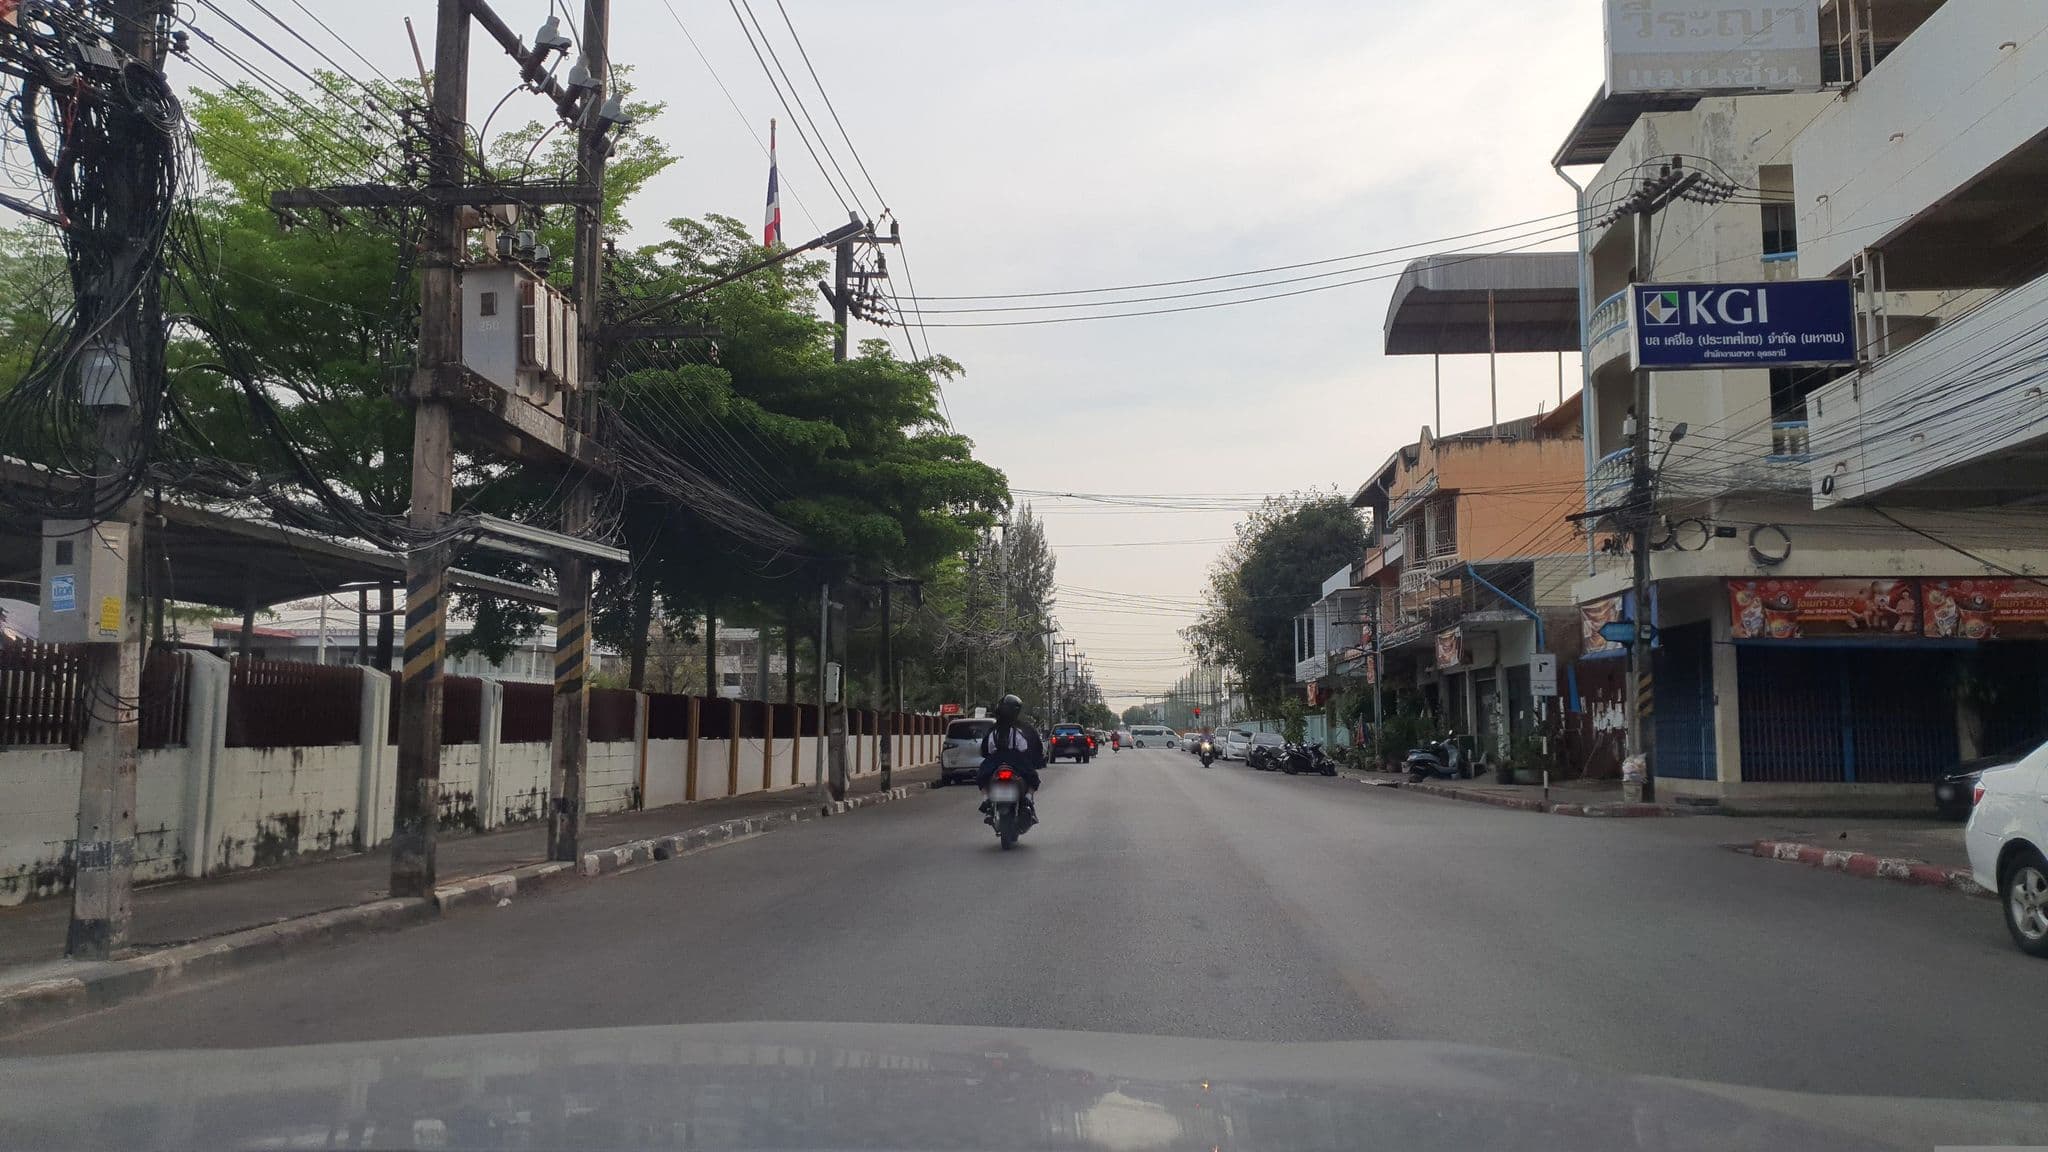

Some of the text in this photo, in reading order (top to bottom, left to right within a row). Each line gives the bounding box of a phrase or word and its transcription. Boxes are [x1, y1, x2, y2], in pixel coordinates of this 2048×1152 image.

[1687, 288, 1769, 325] KGI
[1664, 331, 1693, 346] เคจีไอ
[1698, 331, 1763, 347] (ประเทศไทย)
[1767, 331, 1796, 345] จำกัด
[1801, 331, 1845, 345] (มหาชน)
